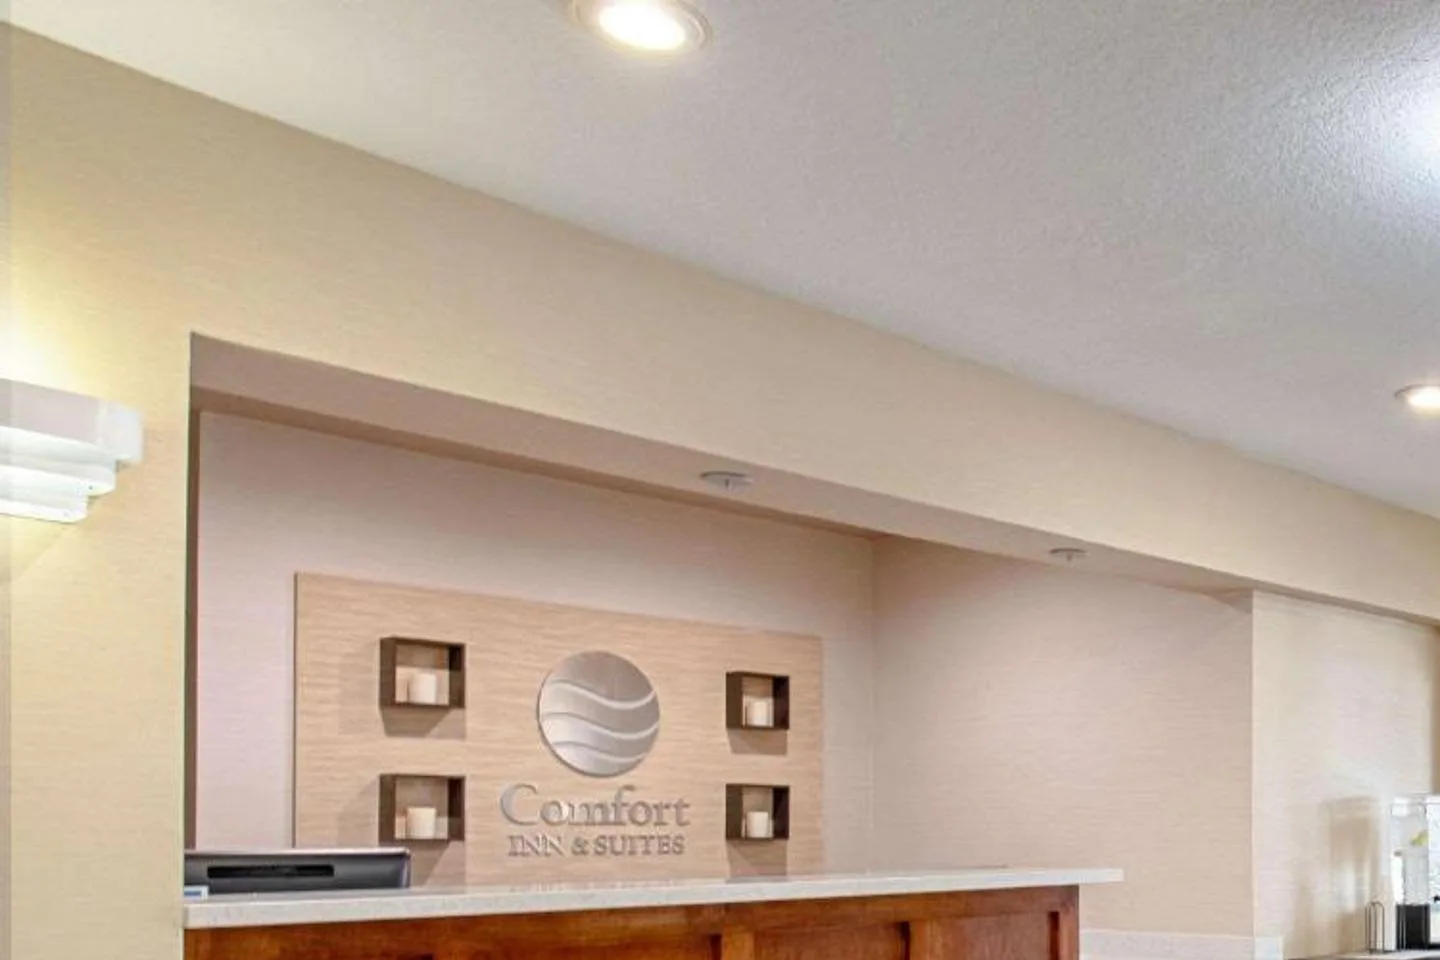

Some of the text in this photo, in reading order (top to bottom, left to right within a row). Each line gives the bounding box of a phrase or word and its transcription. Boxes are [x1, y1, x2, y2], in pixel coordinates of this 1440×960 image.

[499, 783, 691, 827] Comfort
[508, 834, 686, 857] INN & SUITES
